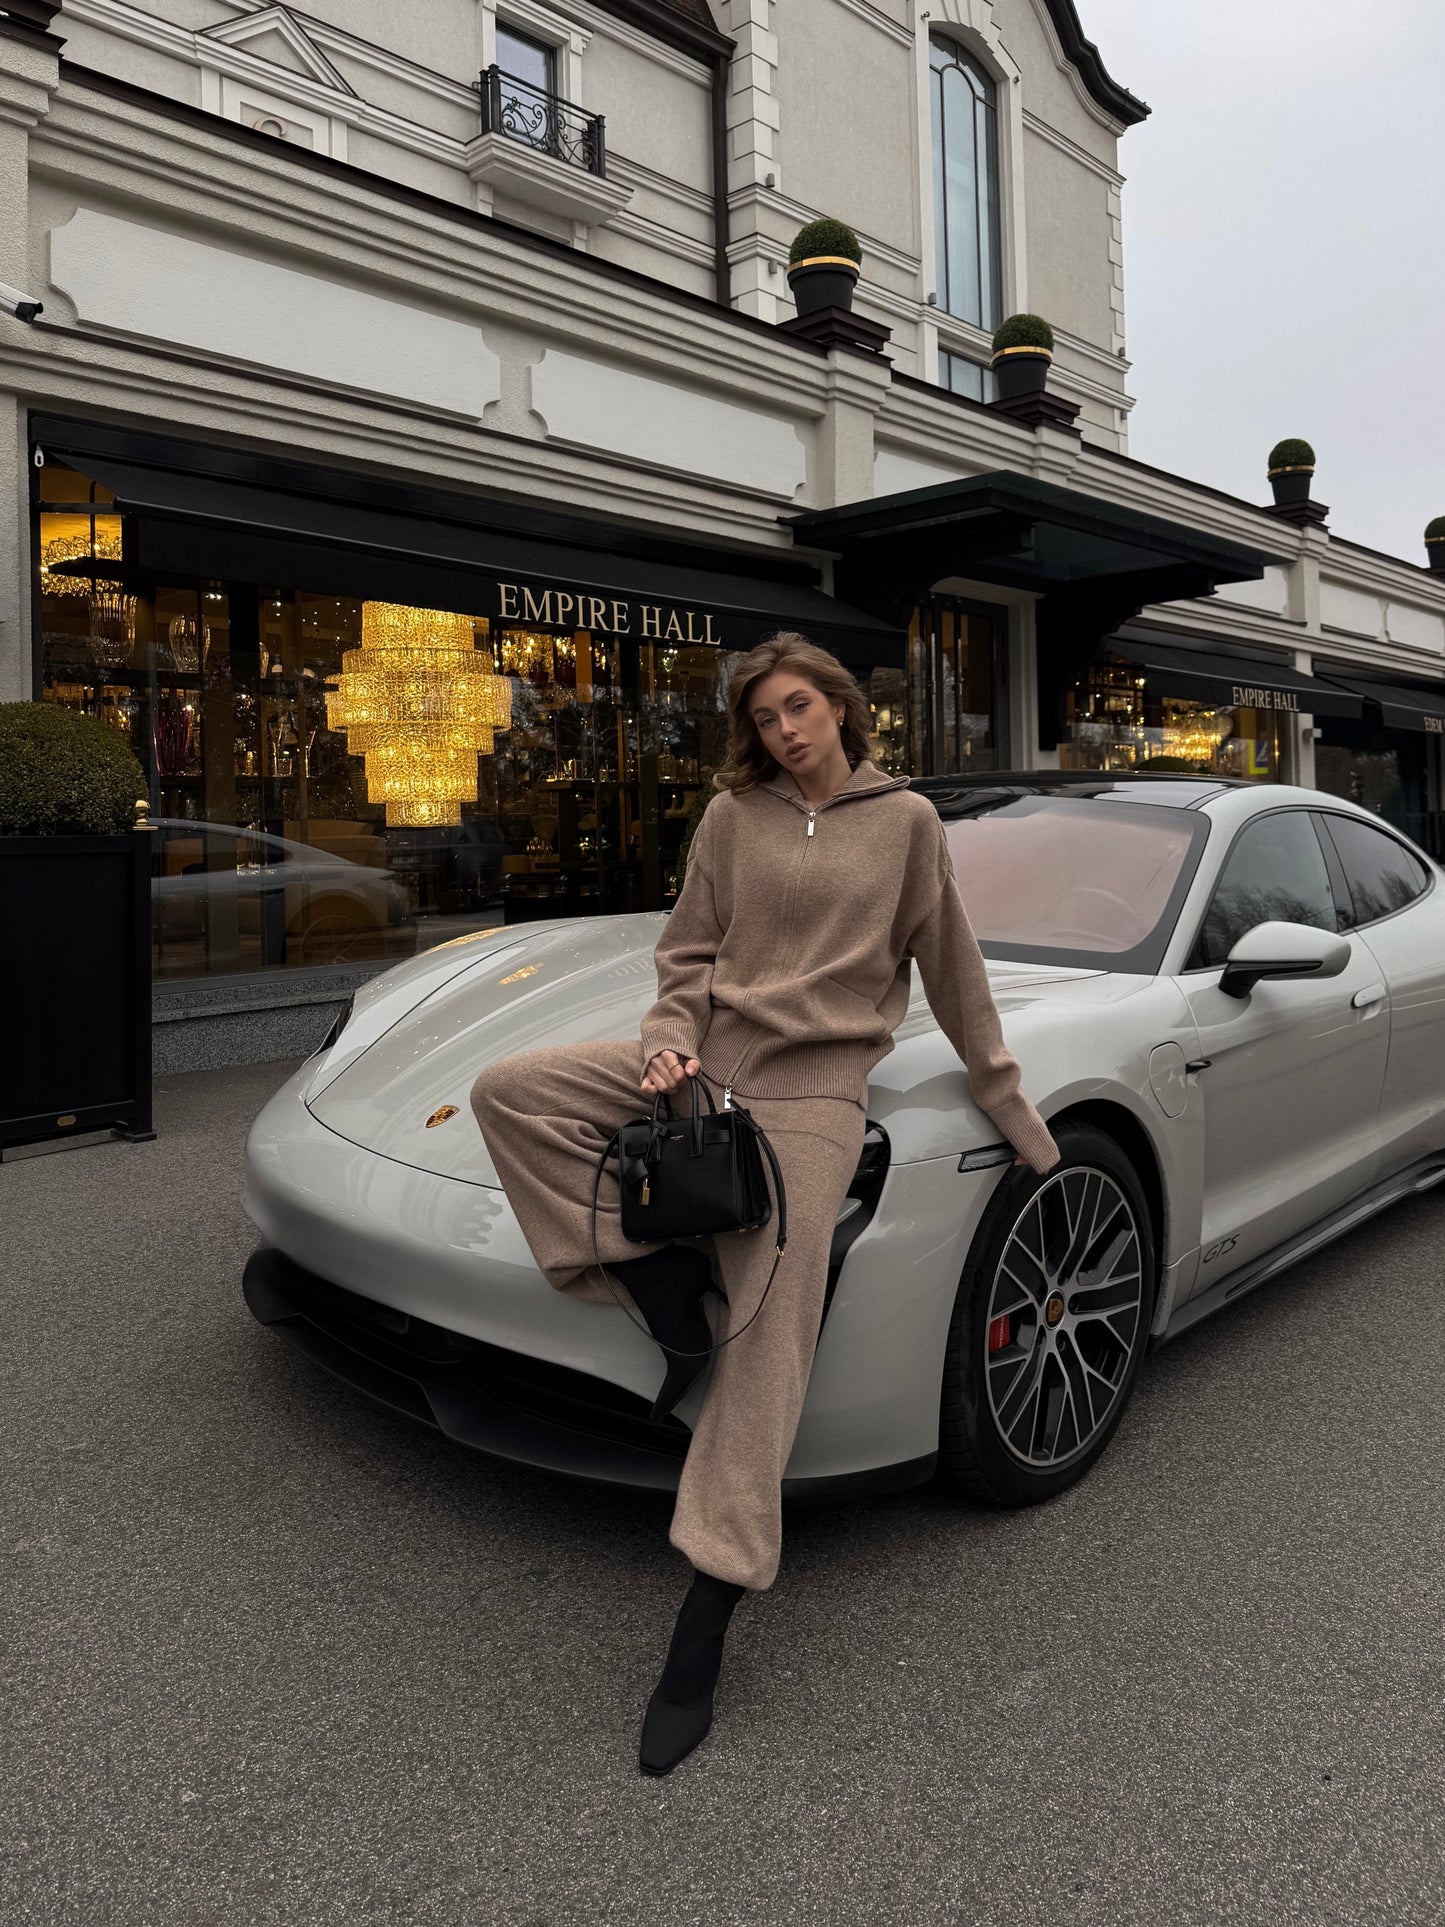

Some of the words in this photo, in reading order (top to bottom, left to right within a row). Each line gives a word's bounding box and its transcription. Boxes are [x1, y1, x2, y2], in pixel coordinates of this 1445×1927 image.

[497, 582, 631, 634] EMPIRE
[640, 604, 722, 645] HALL
[1232, 686, 1271, 709] EMPIRE
[1273, 691, 1300, 712] HALL
[1203, 1233, 1240, 1264] GTS
